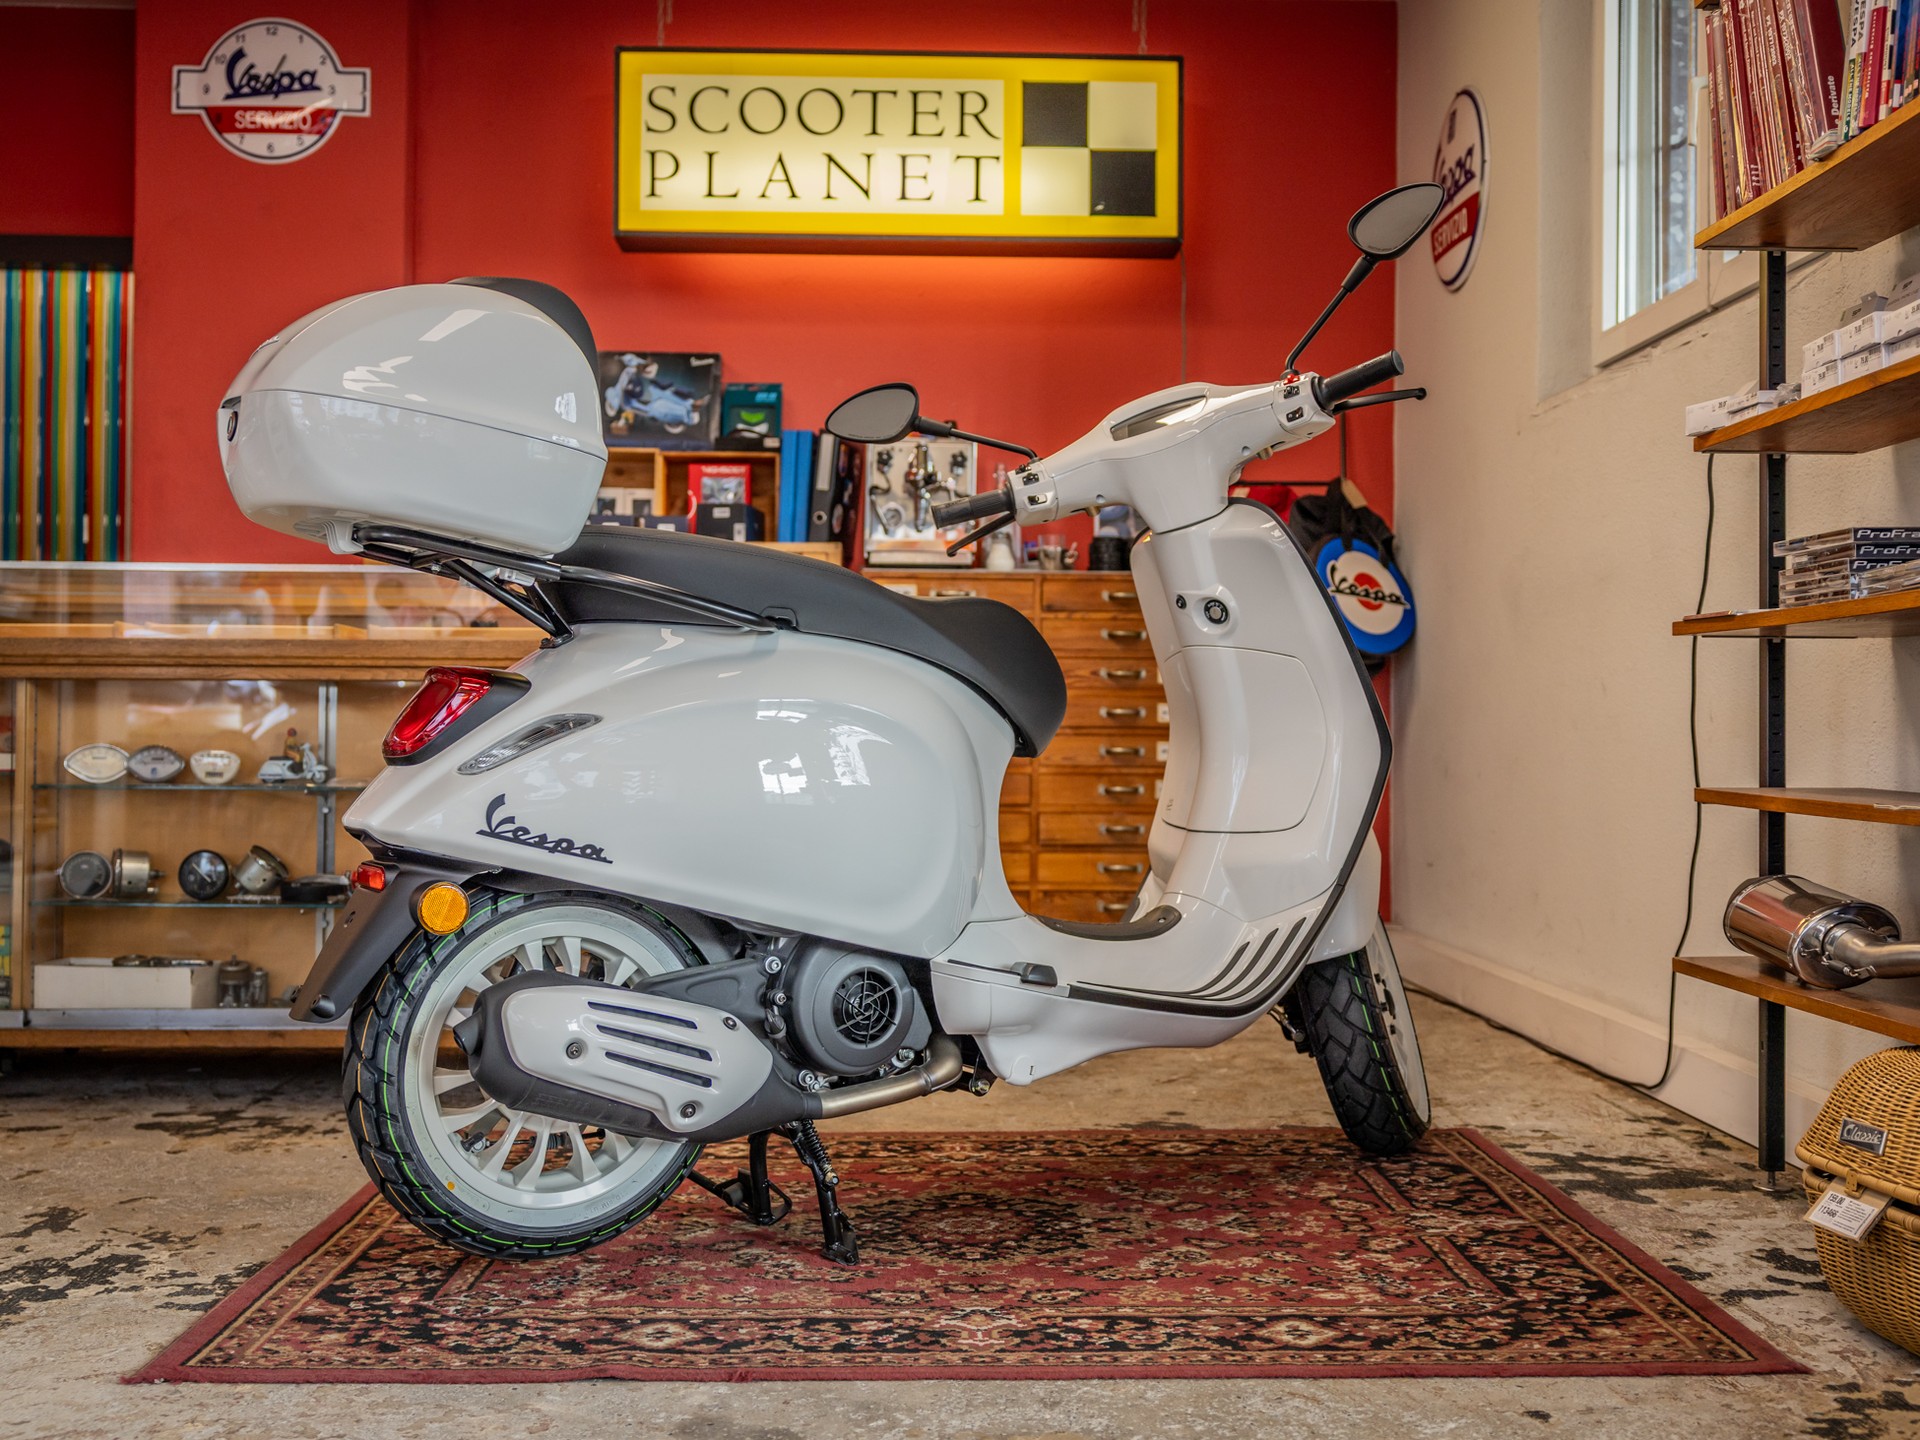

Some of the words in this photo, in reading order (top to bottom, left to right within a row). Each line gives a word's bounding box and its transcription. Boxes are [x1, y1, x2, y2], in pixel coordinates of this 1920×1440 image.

[222, 46, 322, 99] Vespa
[1827, 75, 1839, 116] Derivate
[234, 110, 312, 129] SERVIZIO
[645, 84, 1001, 141] SCOOTER
[645, 149, 1001, 203] PLANET
[1434, 207, 1468, 256] SERVIZIO
[1330, 563, 1408, 606] Vespa
[476, 793, 613, 864] Vespa
[1841, 1124, 1881, 1144] Classic
